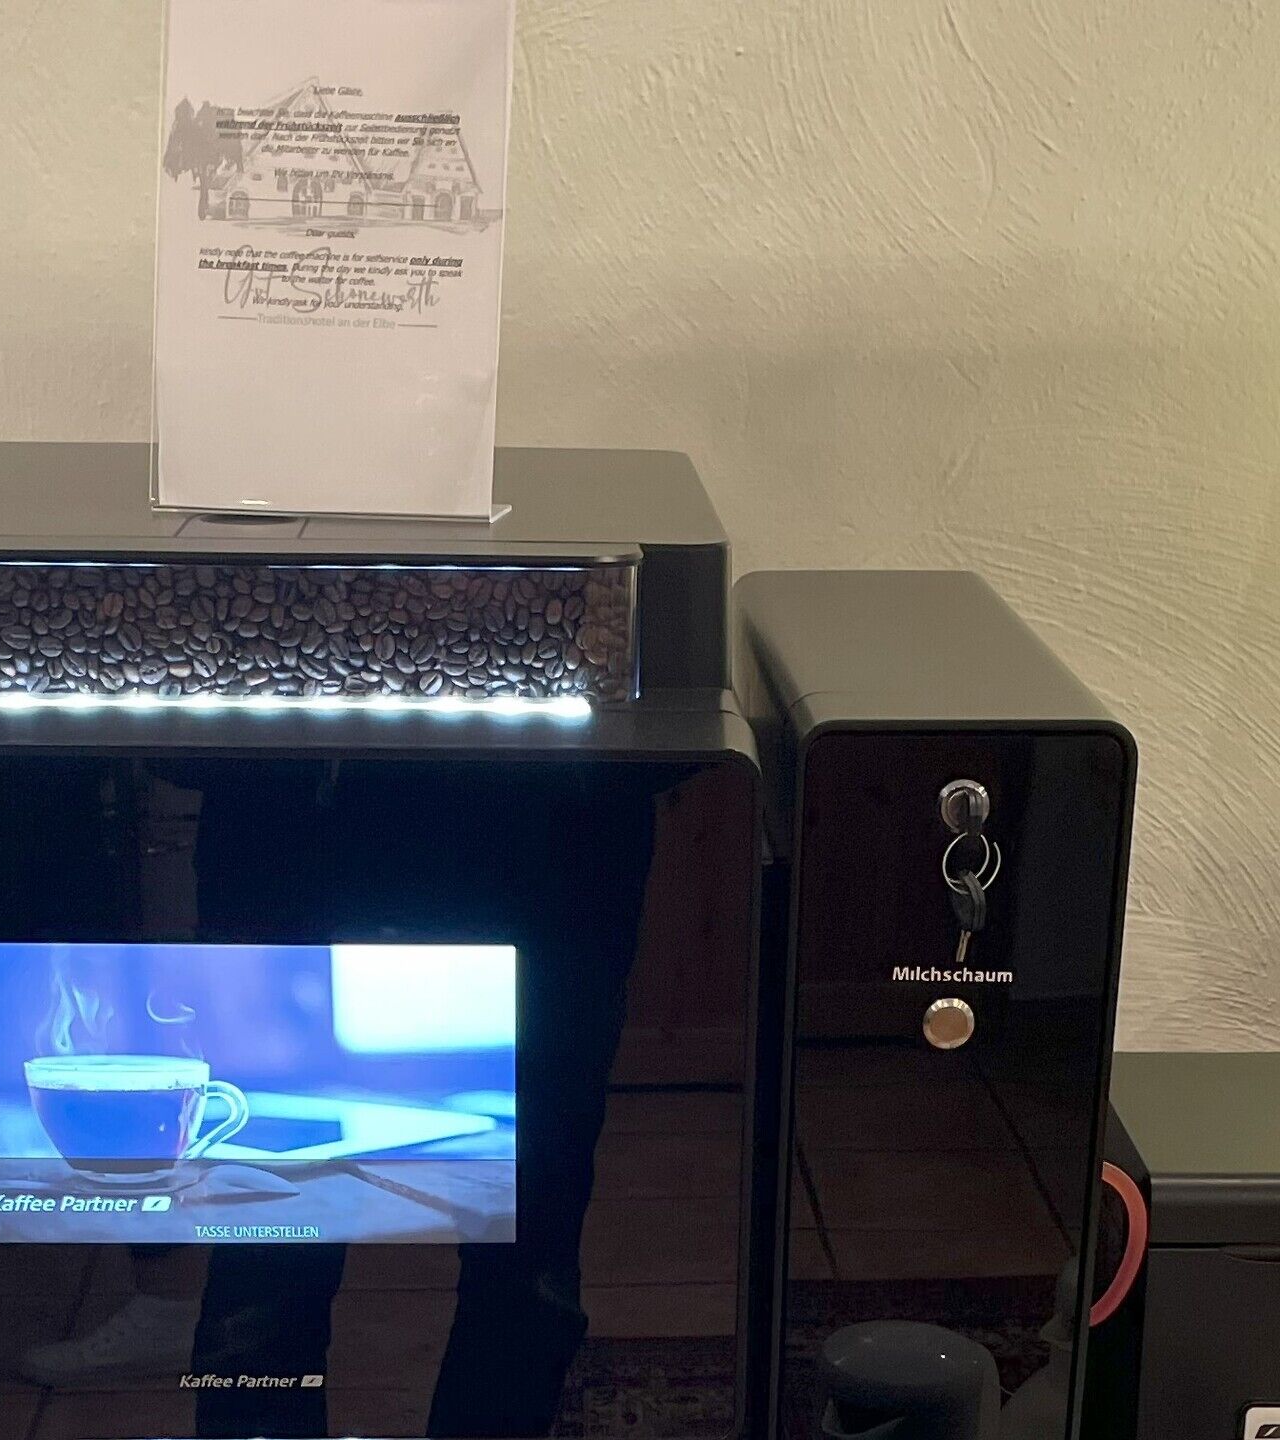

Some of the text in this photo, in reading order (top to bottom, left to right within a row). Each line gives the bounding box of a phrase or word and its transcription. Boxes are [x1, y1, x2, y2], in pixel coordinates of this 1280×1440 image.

[892, 966, 1013, 983] Milchschaum
[60, 1194, 138, 1213] Partner
[195, 1225, 319, 1239] TASSE UNTERSTELLEN
[179, 1374, 298, 1388] Kaffee Partner
